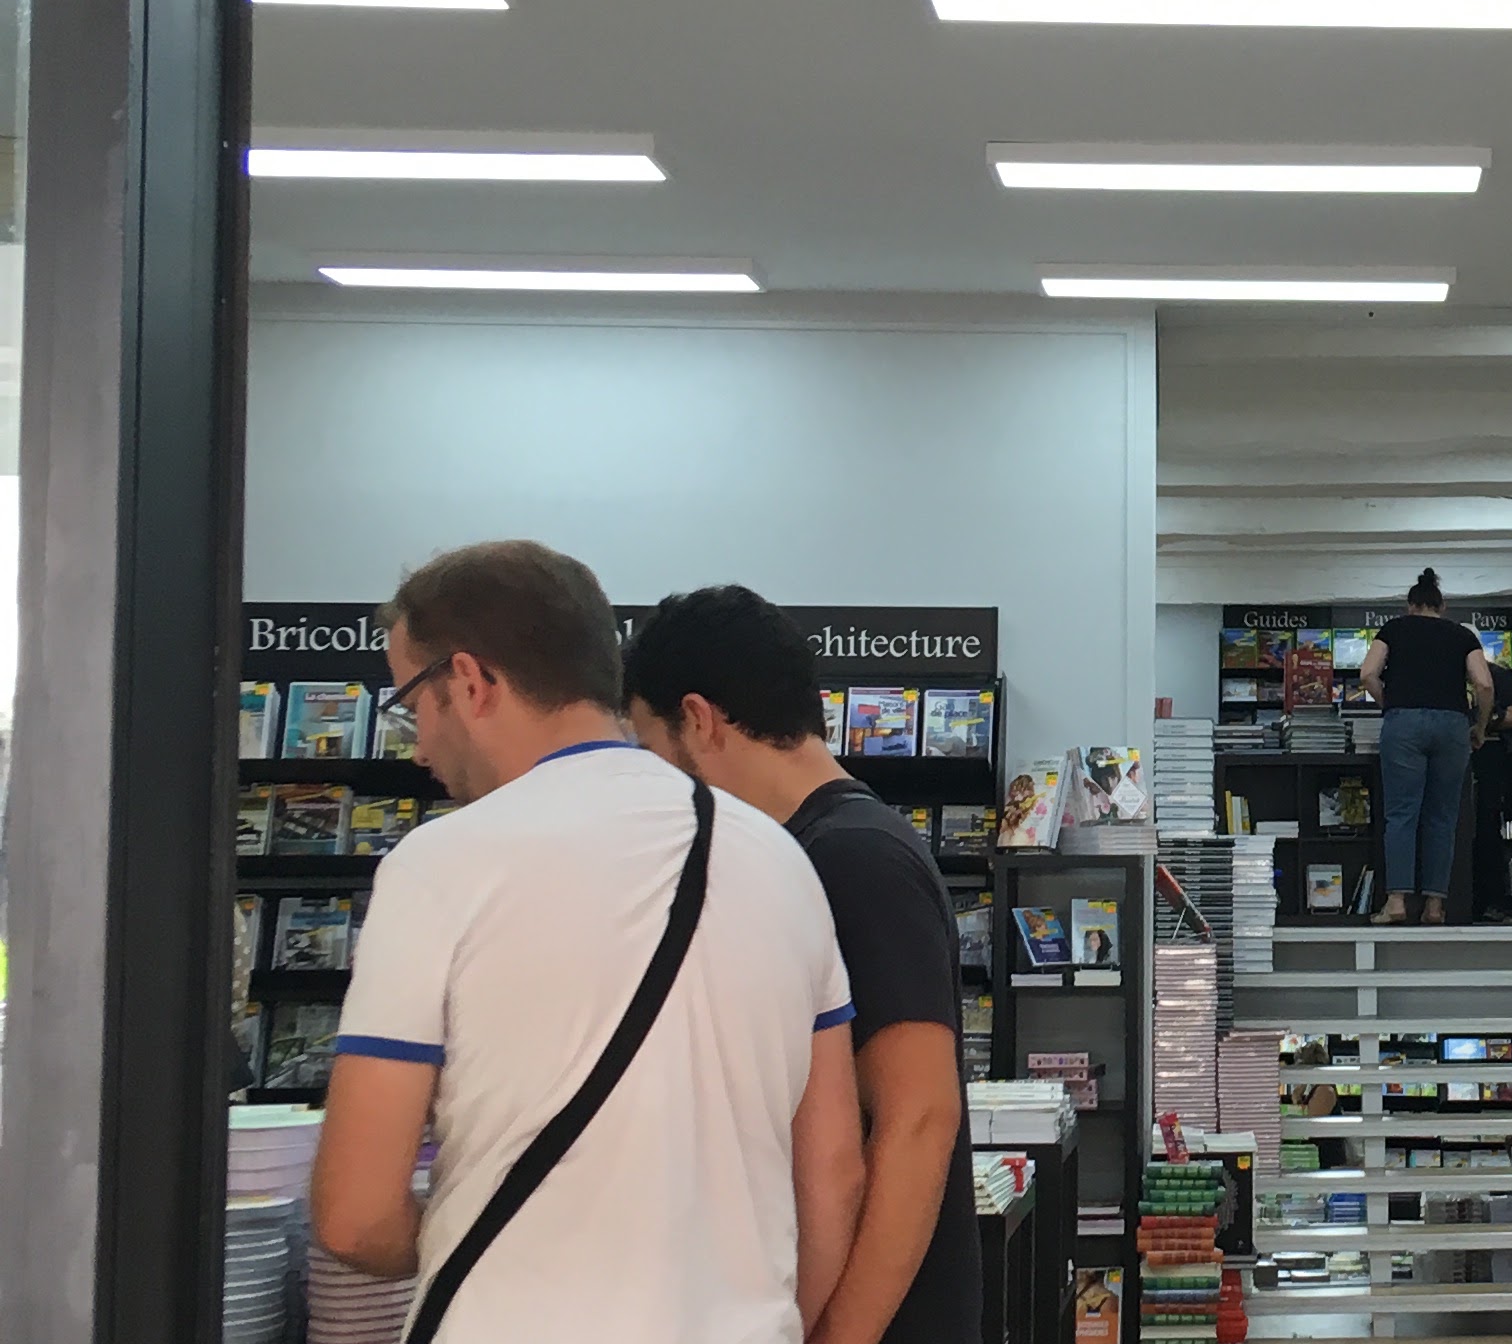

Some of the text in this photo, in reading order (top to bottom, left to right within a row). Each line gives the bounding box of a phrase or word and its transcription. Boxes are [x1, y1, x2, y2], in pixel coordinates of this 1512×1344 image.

[1243, 610, 1309, 629] Guides
[1365, 612, 1401, 627] Pay
[1471, 612, 1508, 631] Pays
[249, 616, 390, 651] Bricola
[806, 625, 982, 658] chitecture
